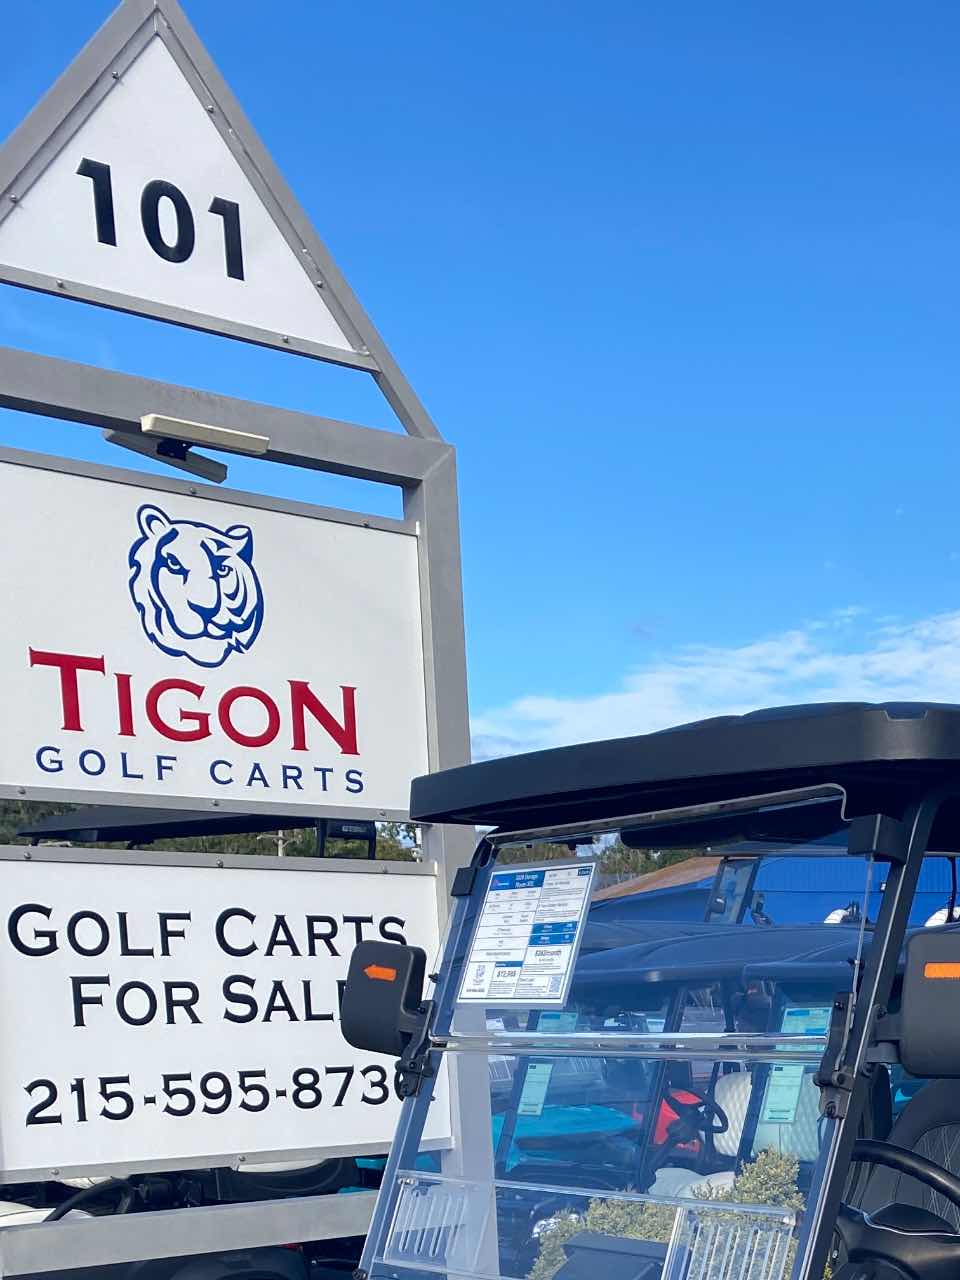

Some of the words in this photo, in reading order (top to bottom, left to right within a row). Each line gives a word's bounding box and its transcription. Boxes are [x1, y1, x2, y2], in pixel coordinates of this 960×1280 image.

[76, 157, 245, 281] 101
[29, 647, 360, 755] TIGON
[36, 746, 177, 781] GOLF
[209, 759, 364, 794] CARTS
[7, 903, 192, 959] GOLF
[69, 974, 203, 1027] FOR
[222, 974, 347, 1024] SAL
